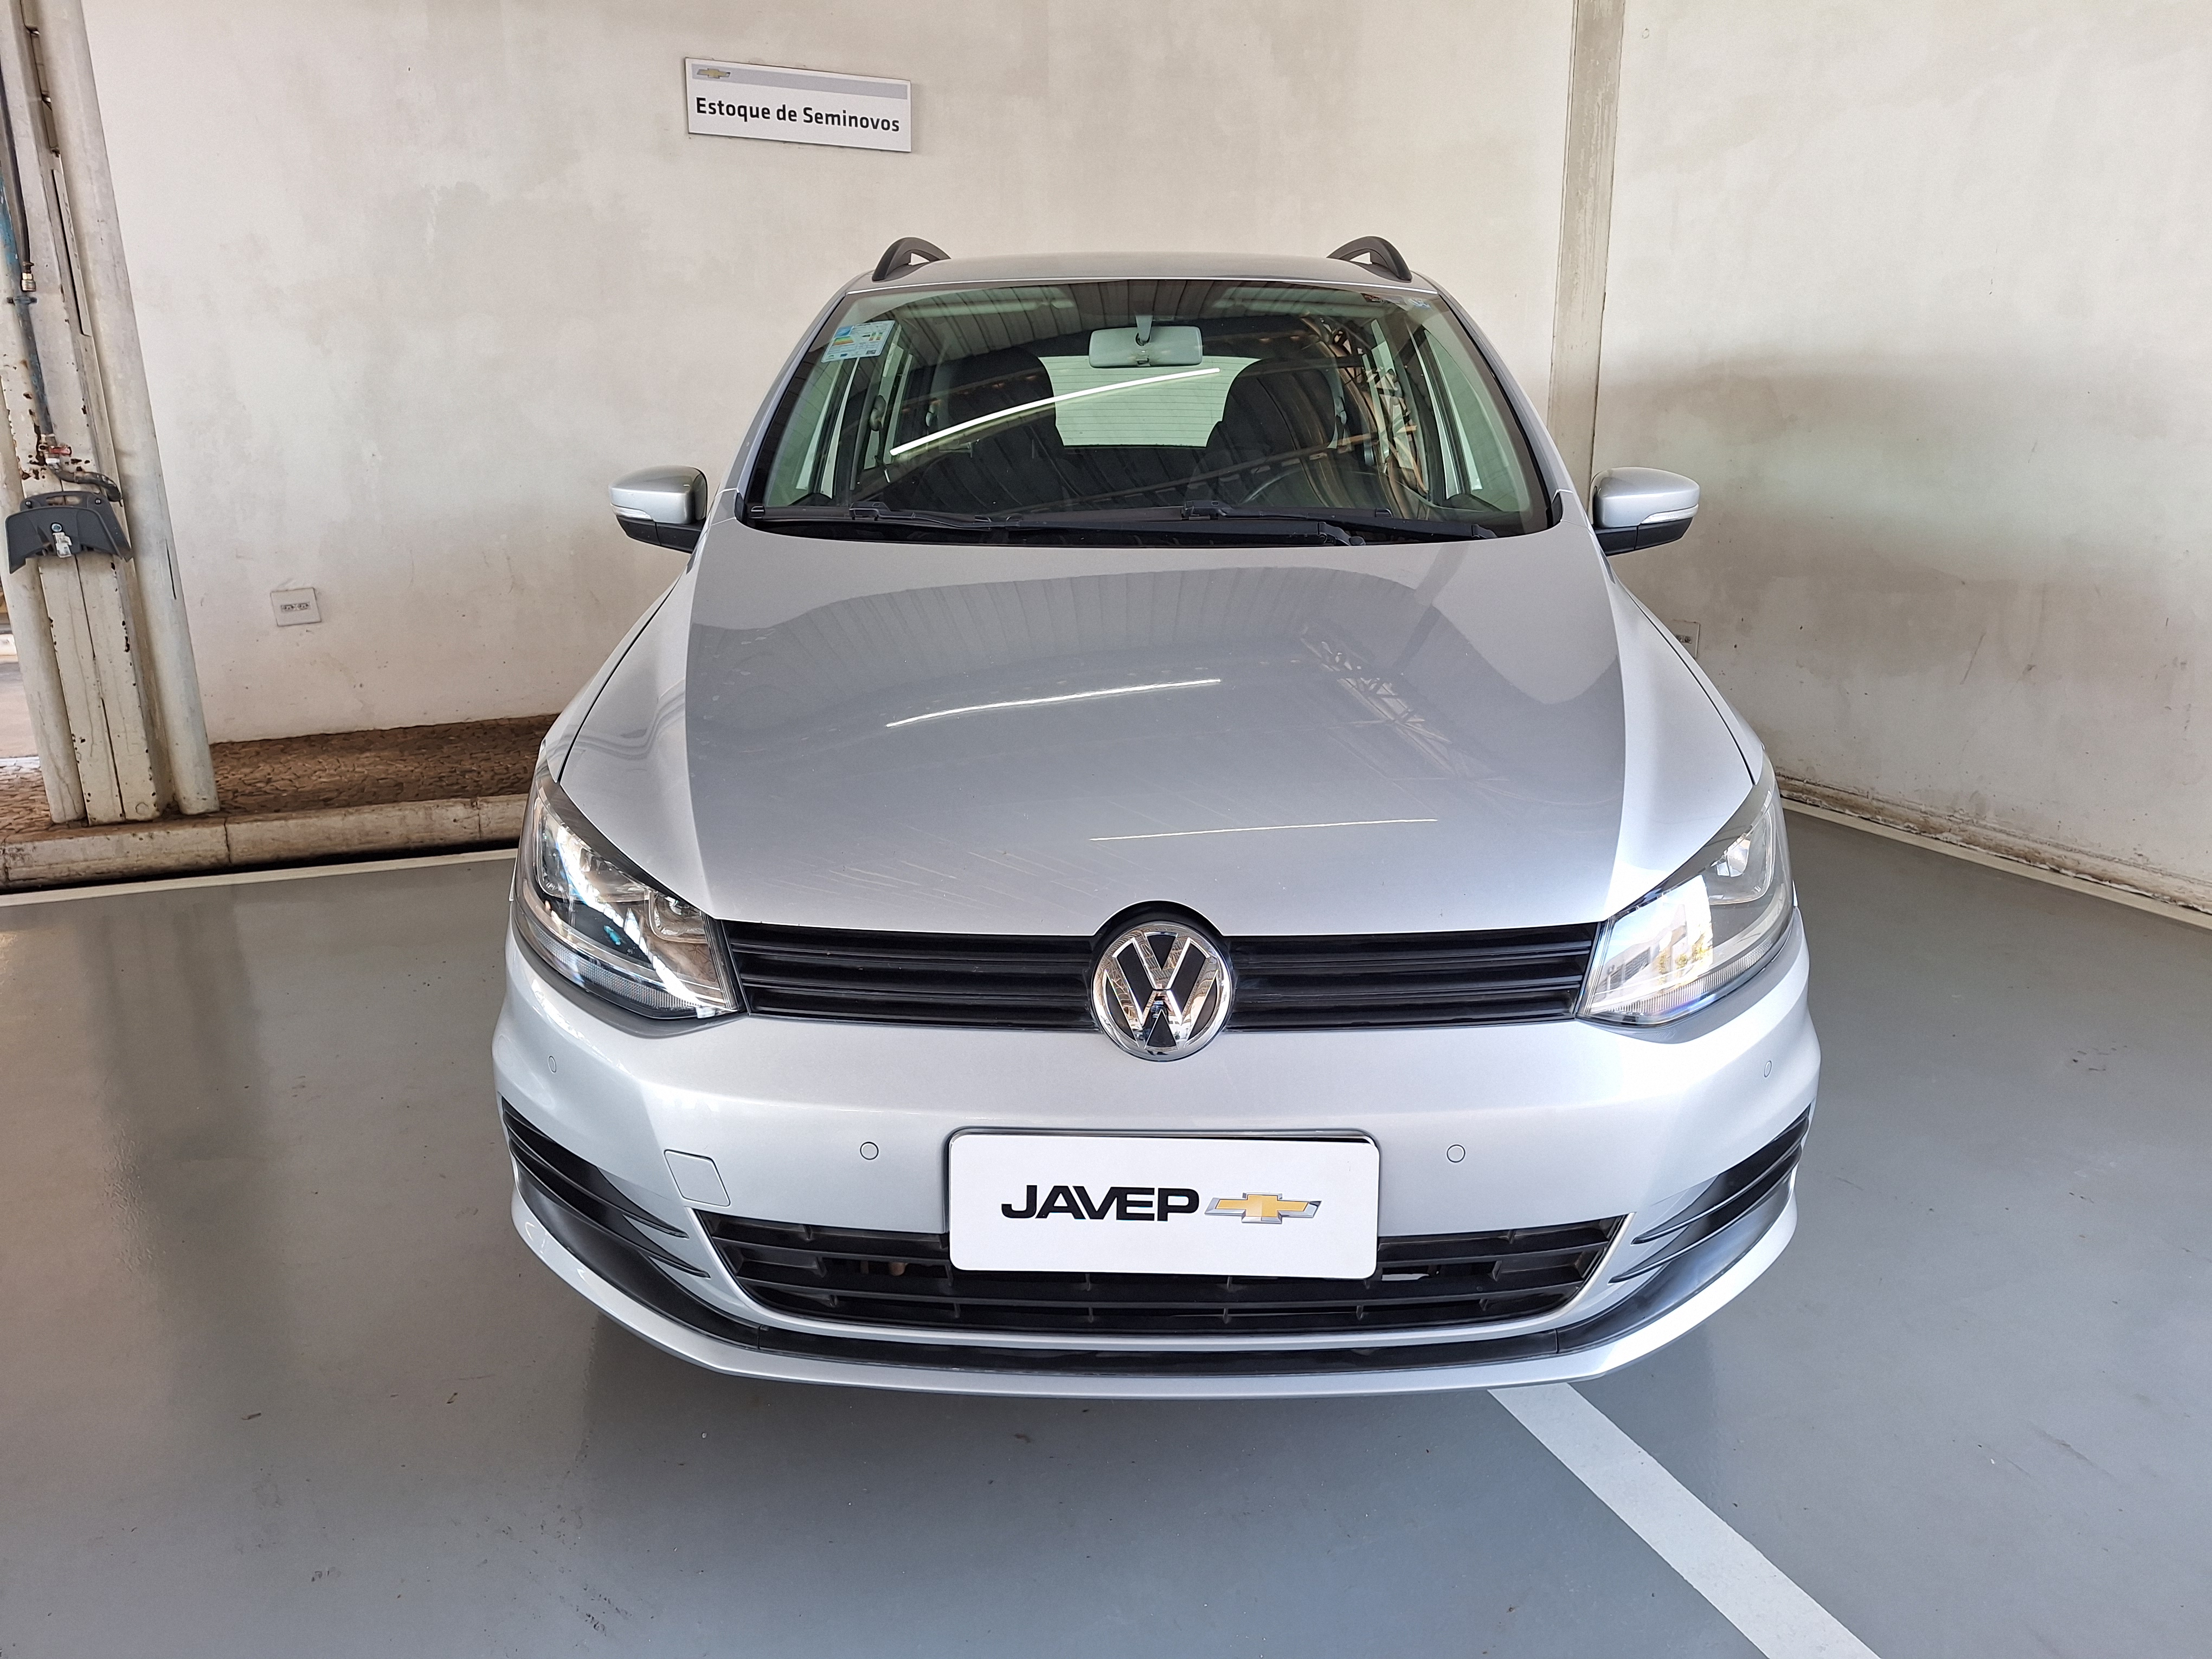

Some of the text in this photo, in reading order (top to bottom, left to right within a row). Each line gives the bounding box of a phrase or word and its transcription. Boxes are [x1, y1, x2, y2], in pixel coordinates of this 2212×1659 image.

[696, 97, 899, 132] Estoque de Seminovos
[1001, 1185, 1200, 1221] JAVEP
